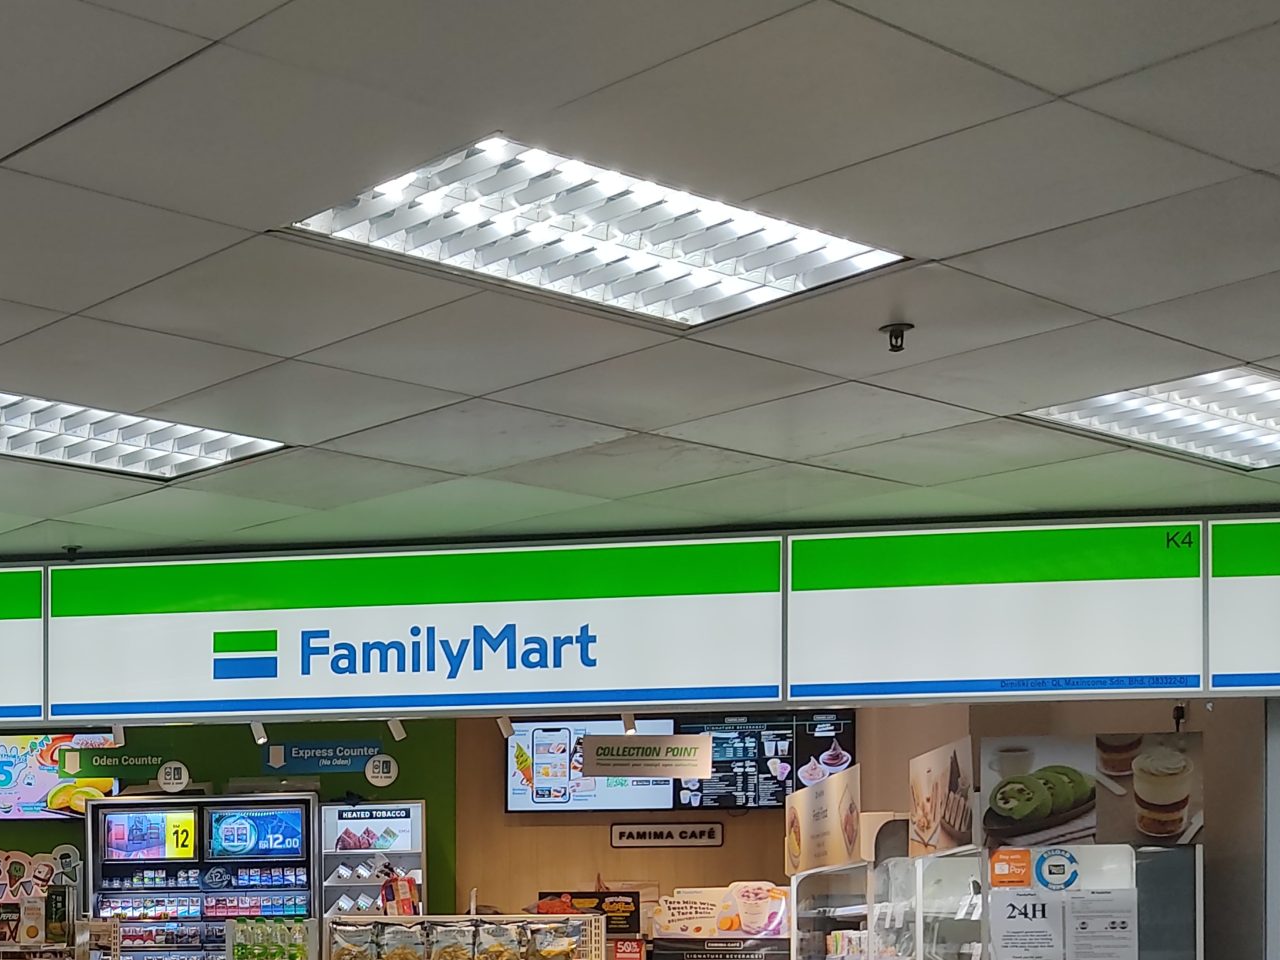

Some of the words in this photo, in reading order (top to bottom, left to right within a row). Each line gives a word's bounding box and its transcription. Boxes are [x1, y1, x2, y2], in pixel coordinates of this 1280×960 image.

[1166, 531, 1193, 549] K4
[300, 623, 597, 679] FamilyMart
[291, 746, 333, 760] Express
[337, 745, 379, 757] Counter
[596, 746, 660, 757] COLLECTION
[665, 747, 698, 757] POINT
[92, 755, 119, 766] Oden
[121, 754, 162, 767] Counter
[319, 757, 331, 767] (No
[331, 757, 351, 767] Oden)
[372, 810, 406, 818] TOBACCO
[172, 829, 188, 848] 12
[619, 831, 675, 840] FAMIMA
[679, 828, 715, 840] CAFÉ
[268, 834, 299, 848] 12.00
[1009, 866, 1026, 876] Pay
[1006, 903, 1048, 921] 24H
[617, 941, 640, 952] 50%
